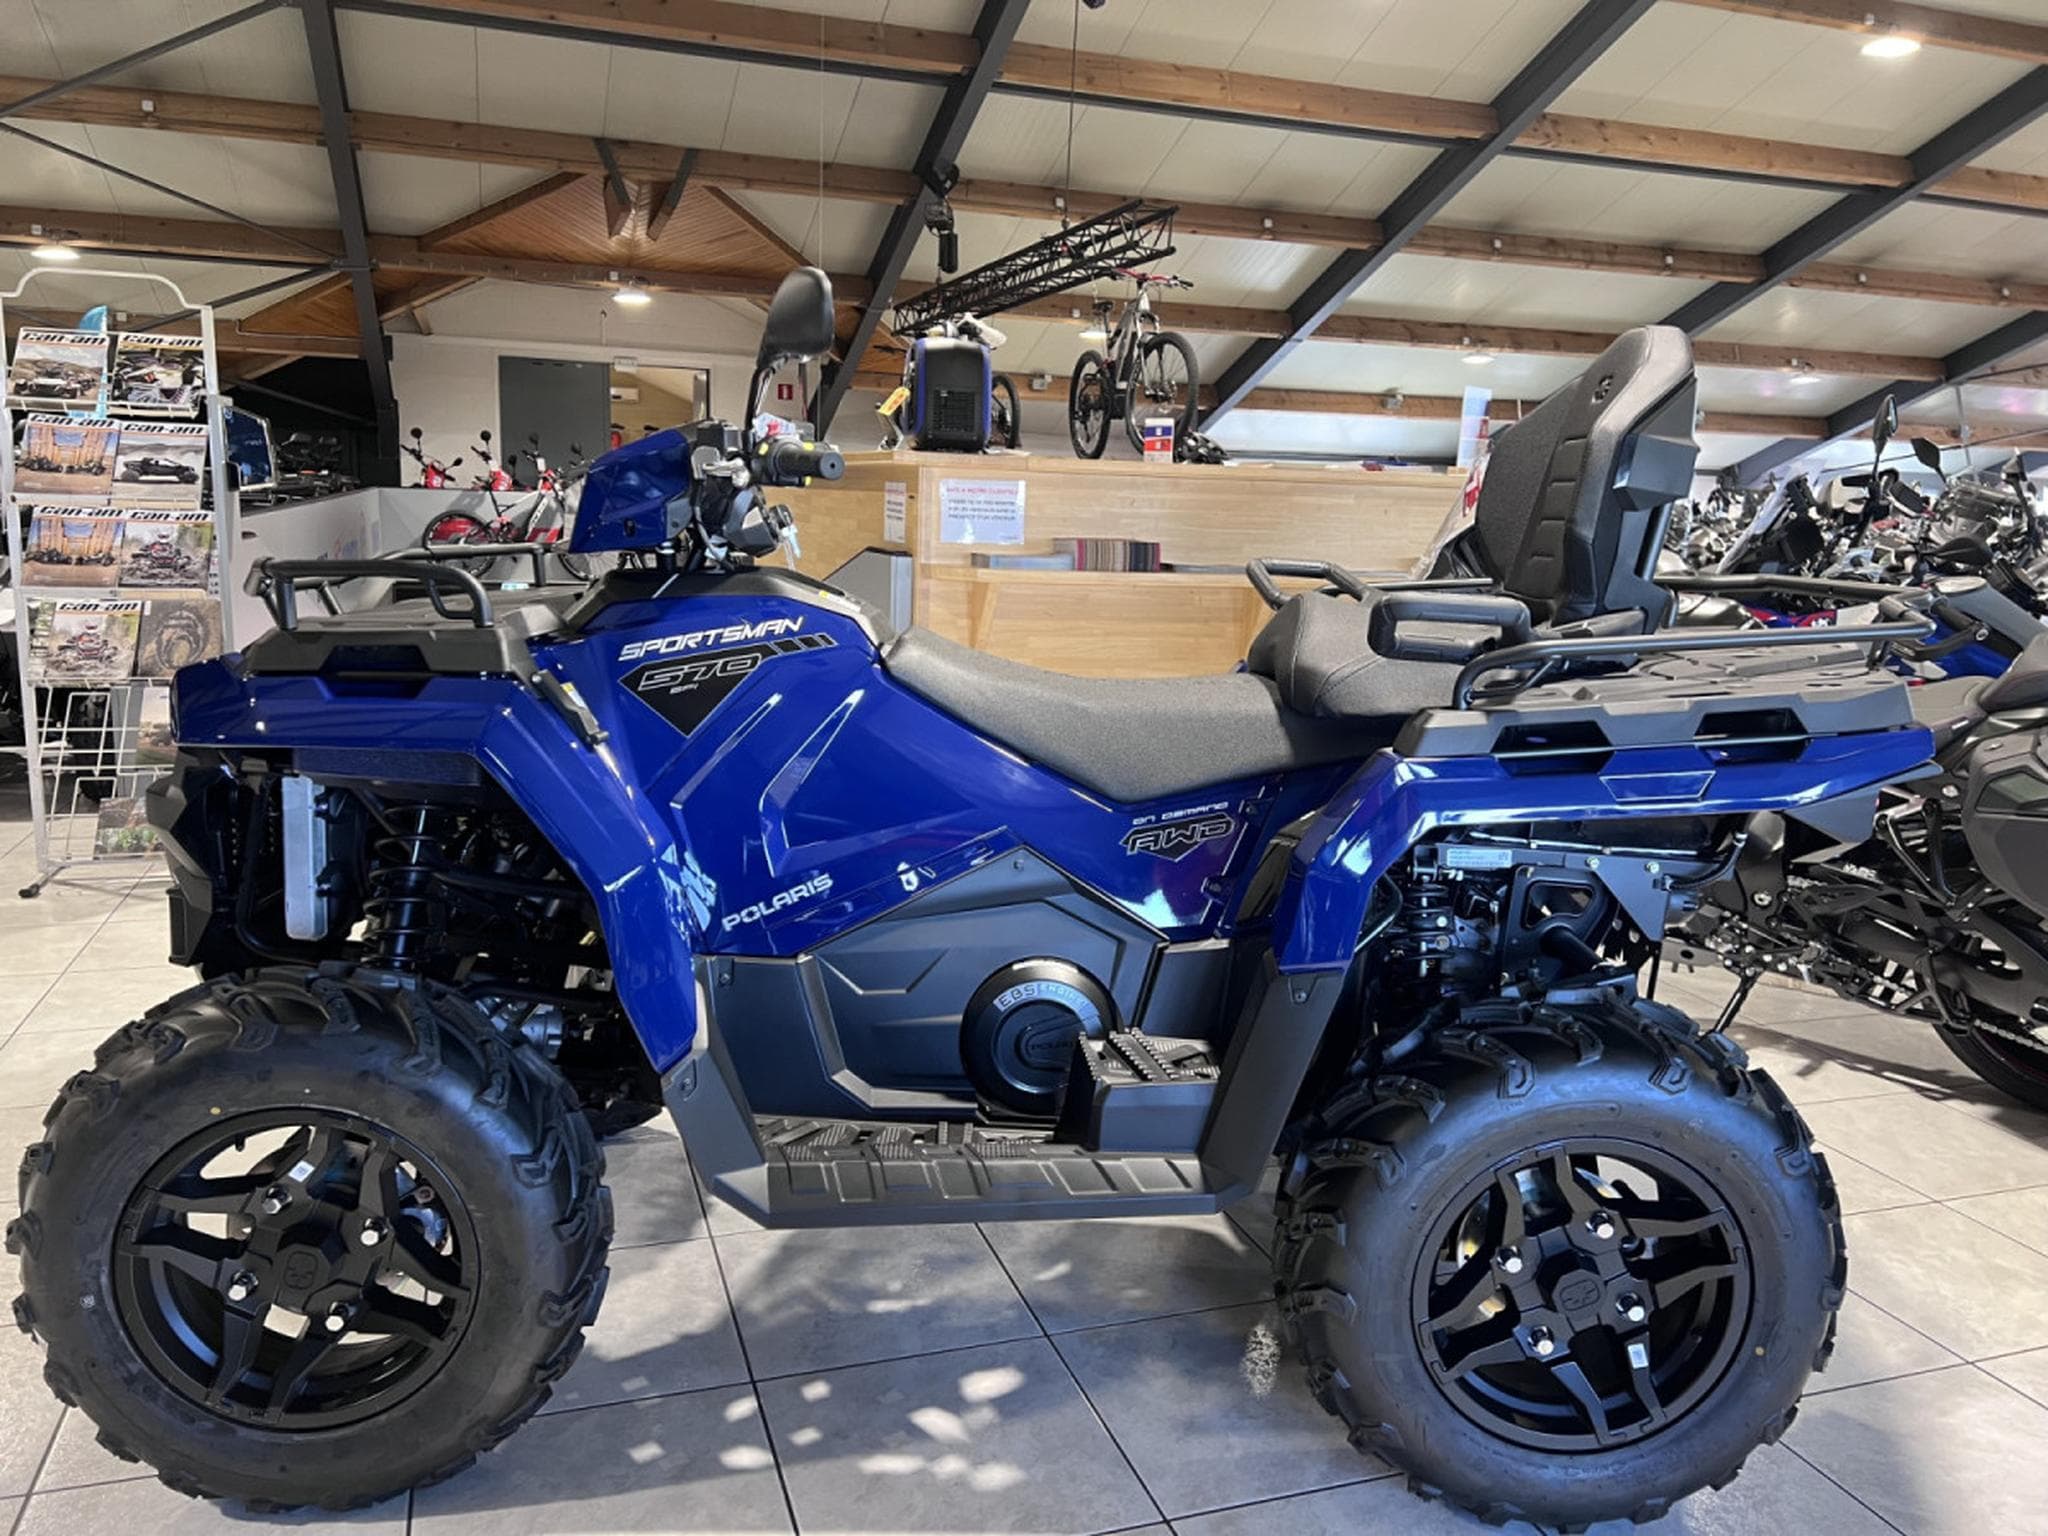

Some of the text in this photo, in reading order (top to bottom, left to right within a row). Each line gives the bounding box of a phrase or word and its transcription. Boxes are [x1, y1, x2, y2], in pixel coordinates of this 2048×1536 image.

[618, 616, 803, 661] SPORTSMAN
[638, 652, 762, 691] 570
[1126, 818, 1234, 856] AWD
[721, 873, 834, 932] POLARIS
[998, 984, 1036, 1007] EBS
